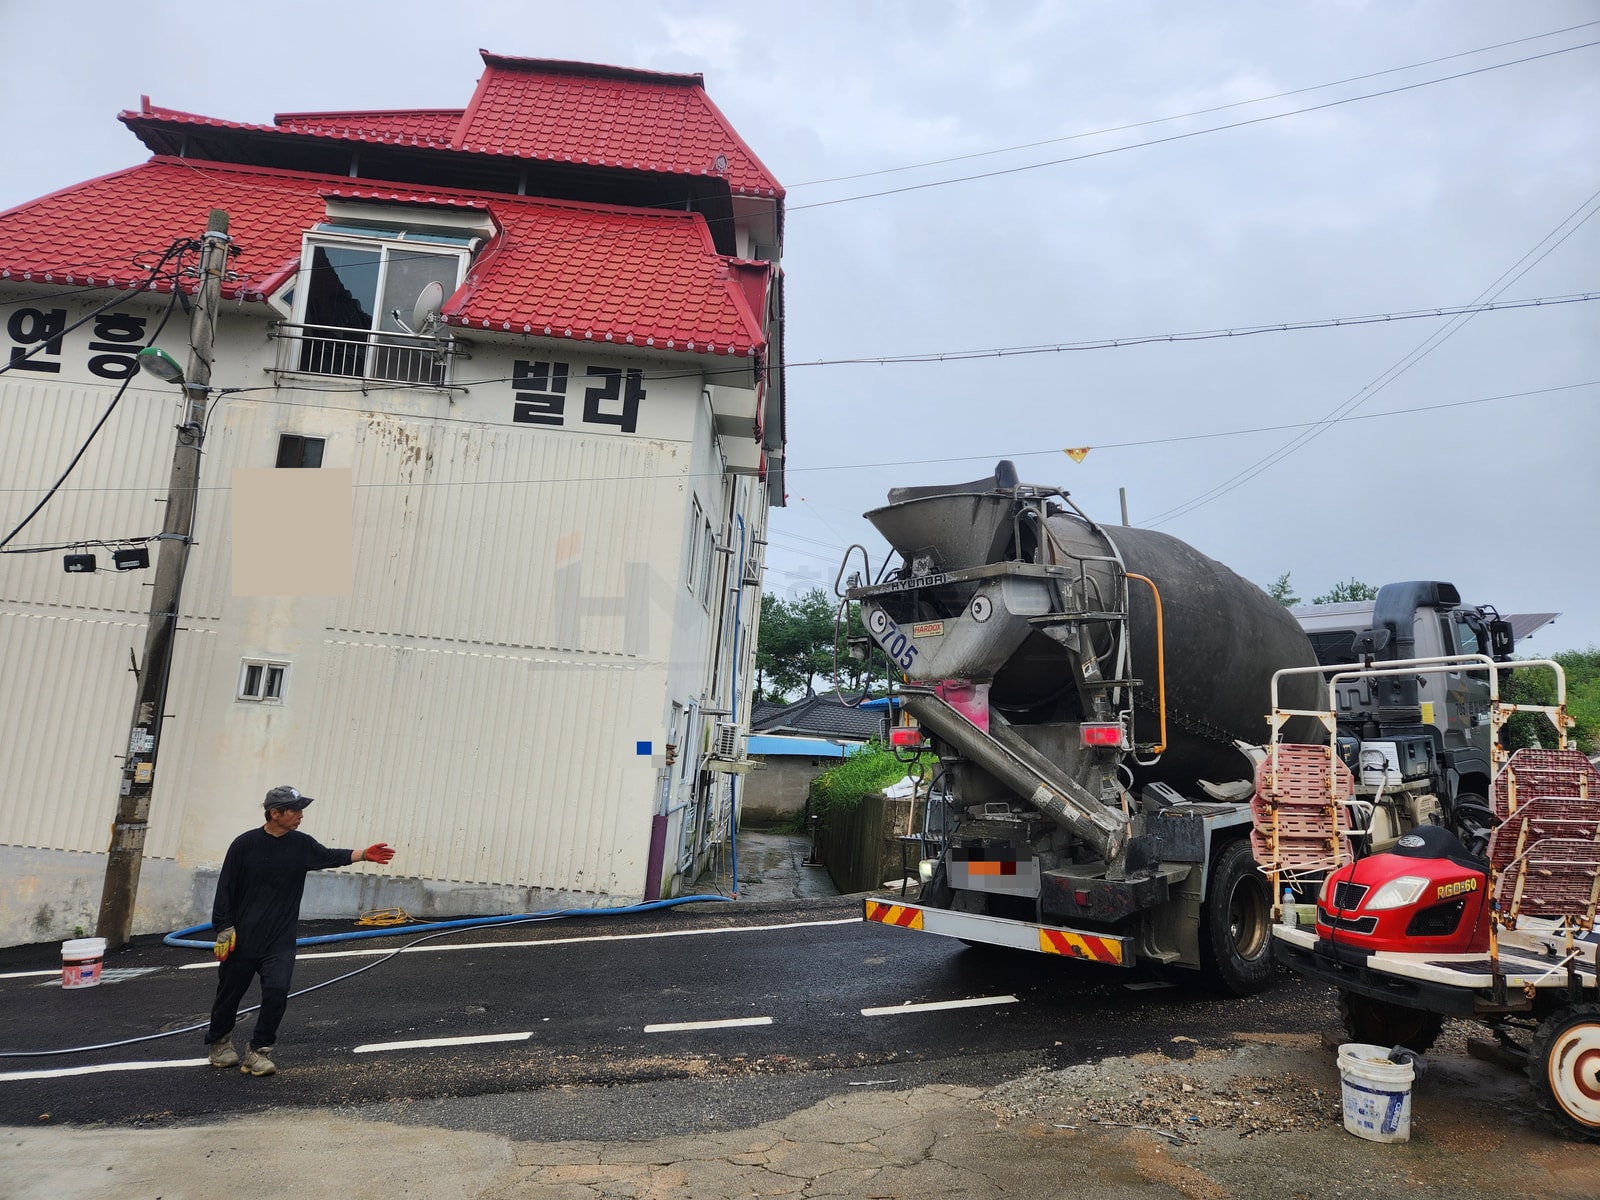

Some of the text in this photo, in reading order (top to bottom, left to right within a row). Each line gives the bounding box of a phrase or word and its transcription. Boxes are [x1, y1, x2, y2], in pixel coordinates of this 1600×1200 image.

[512, 360, 647, 433] 빌라
[891, 573, 947, 591] HYUNDAI
[881, 620, 919, 670] 705
[914, 623, 942, 634] HARDOX
